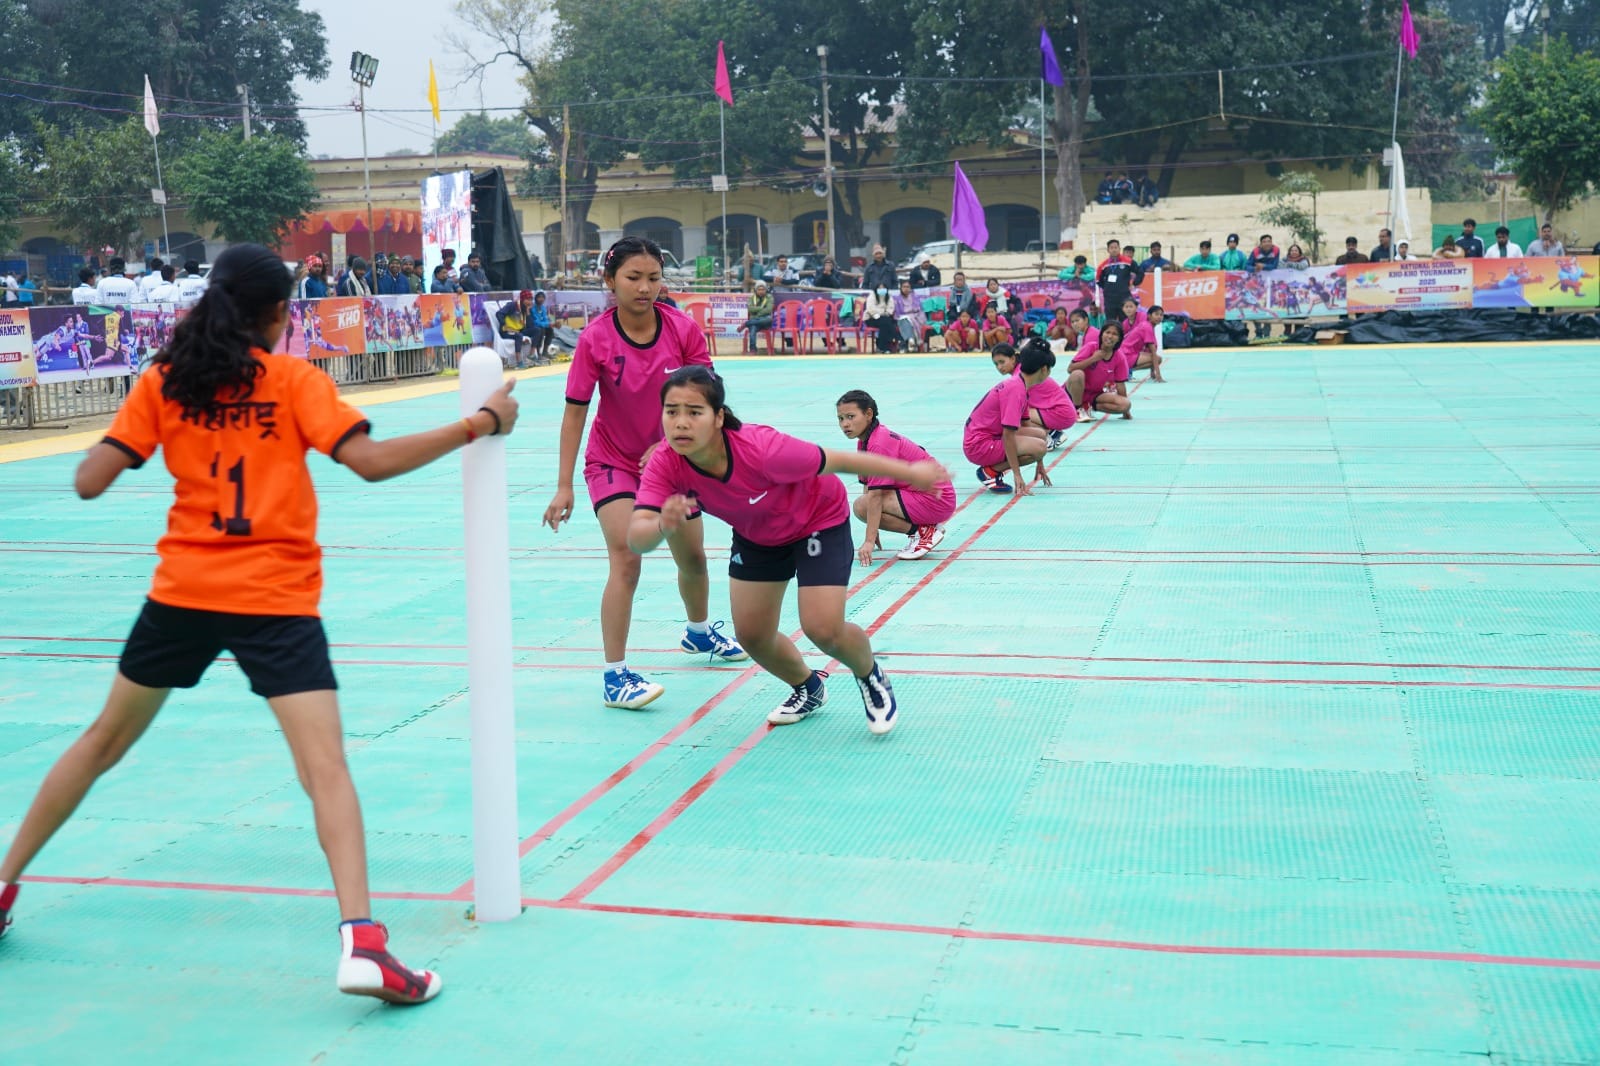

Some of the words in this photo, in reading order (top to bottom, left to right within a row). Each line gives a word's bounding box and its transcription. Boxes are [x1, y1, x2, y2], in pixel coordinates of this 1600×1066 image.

[1401, 262, 1430, 270] NATIONAL
[1431, 261, 1455, 269] SCHOOL
[1420, 268, 1467, 276] TOURNAMENT
[1174, 280, 1218, 297] KHO
[338, 309, 361, 328] KHO
[614, 355, 626, 387] 7
[600, 464, 615, 485] 7
[807, 531, 822, 557] 6
